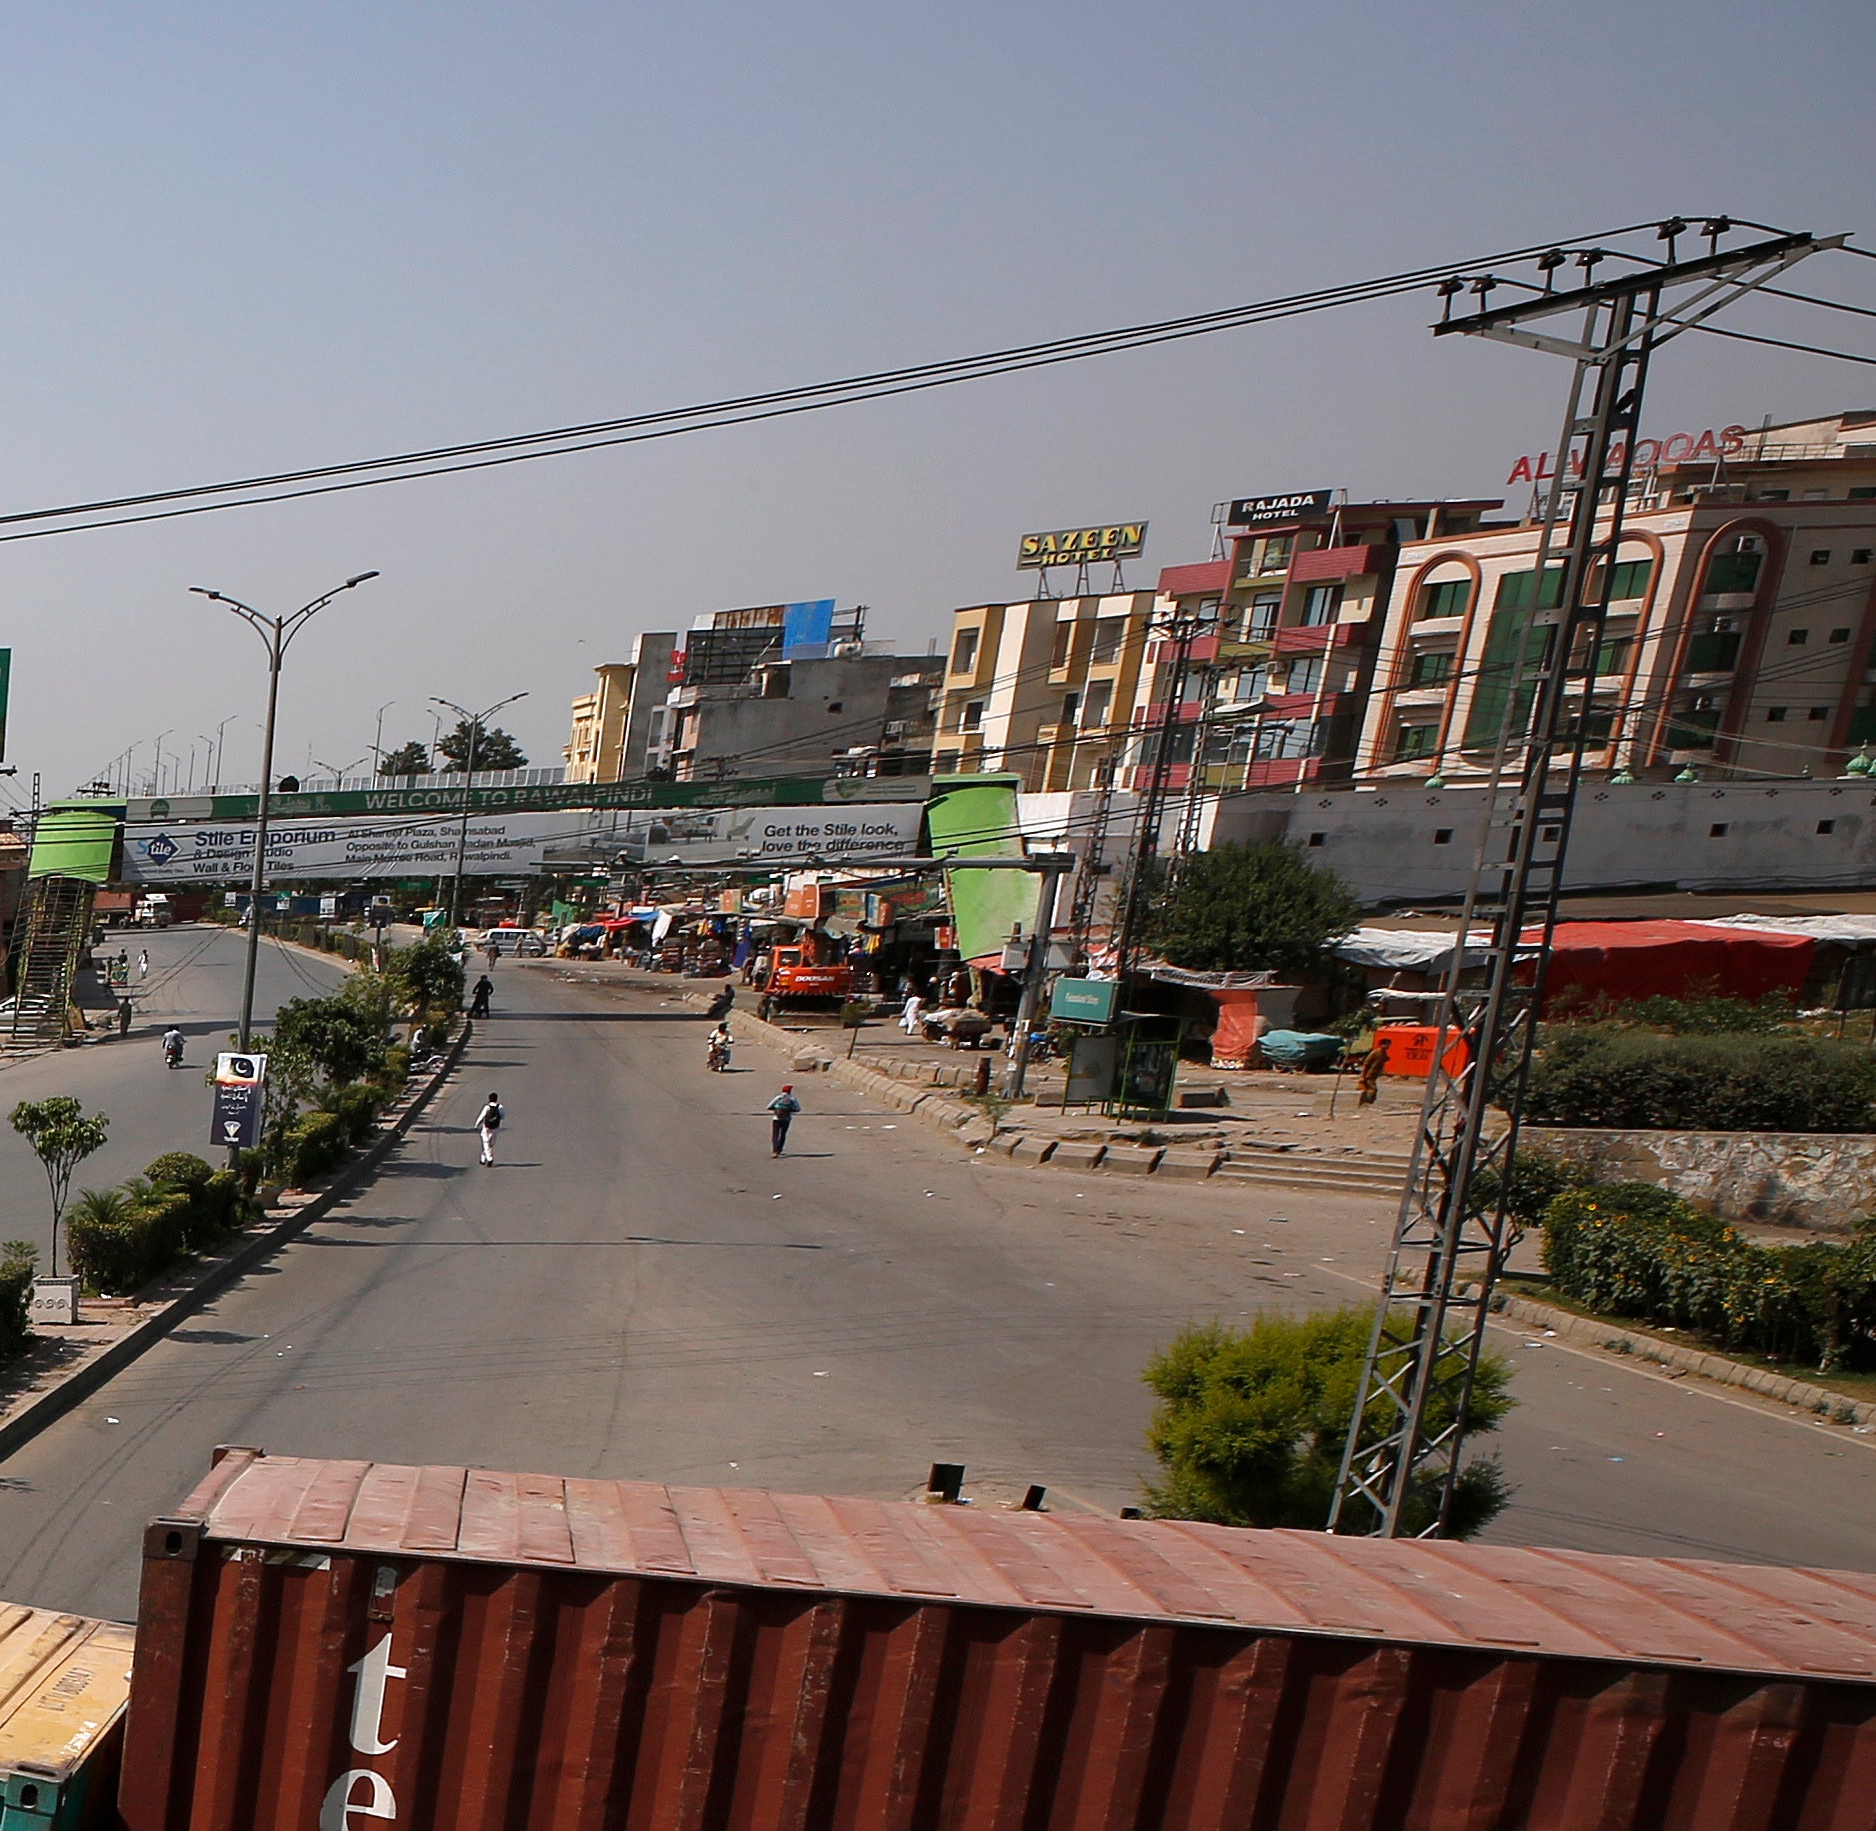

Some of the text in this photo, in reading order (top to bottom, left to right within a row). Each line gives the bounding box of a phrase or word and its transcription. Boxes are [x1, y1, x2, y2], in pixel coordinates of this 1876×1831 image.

[1242, 495, 1314, 512] RAJADA
[1252, 509, 1299, 521] HOTEL
[1022, 525, 1144, 556] SAZEEN
[1041, 548, 1115, 565] HOTEL
[365, 792, 472, 809] WELCOME
[479, 791, 508, 806] TO
[764, 823, 898, 837] Get the Stile look,
[195, 831, 235, 847] Stile
[762, 840, 793, 853] love
[798, 840, 822, 852] the
[193, 862, 220, 874] Wall
[221, 862, 232, 873] &
[267, 860, 295, 872] Tiles
[795, 975, 835, 983] DOOSAN
